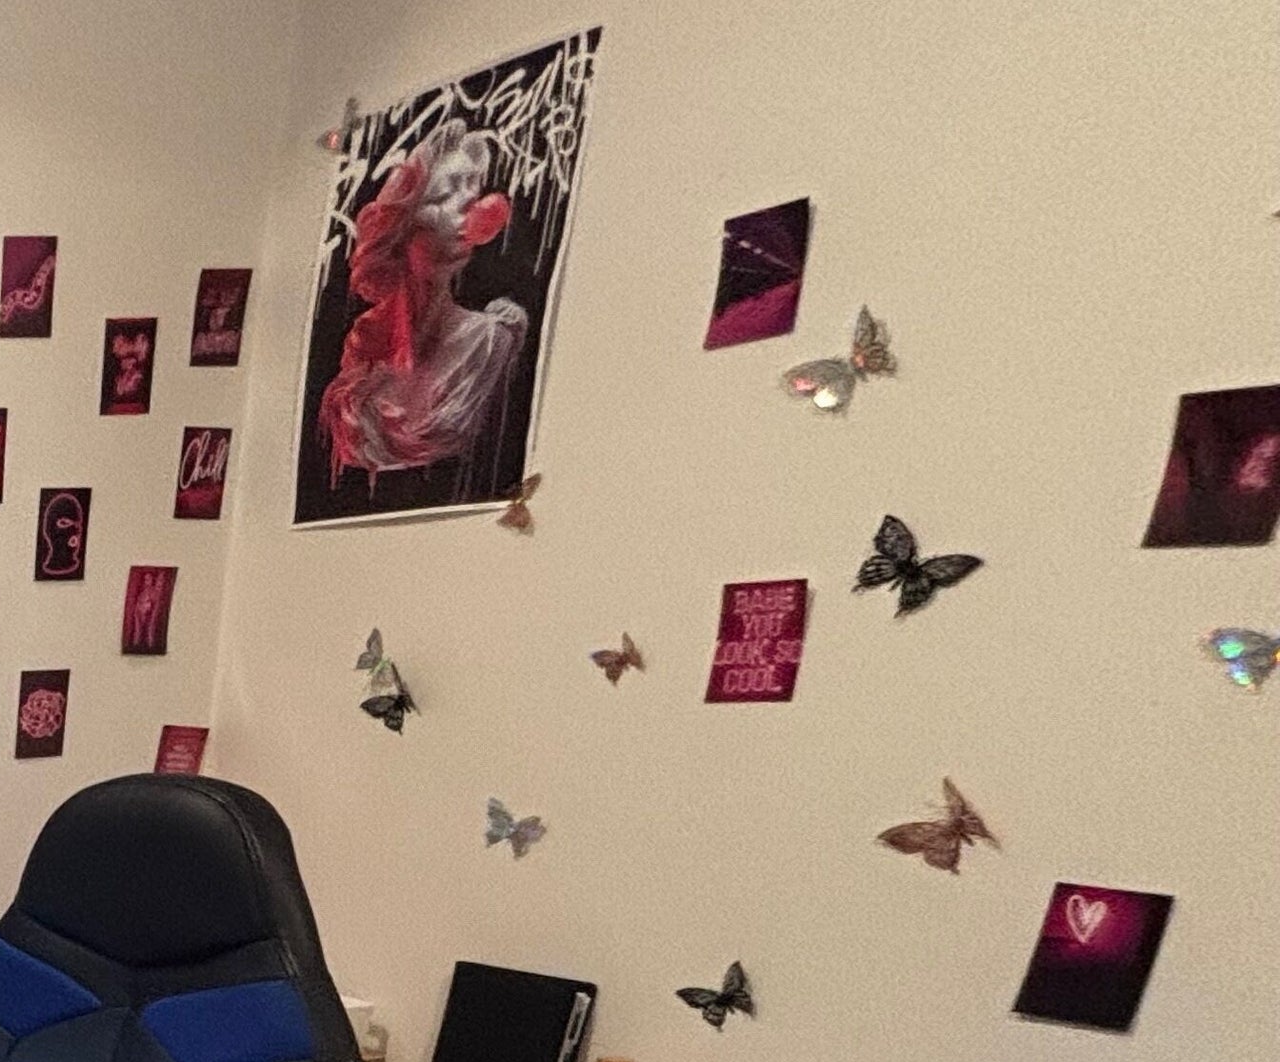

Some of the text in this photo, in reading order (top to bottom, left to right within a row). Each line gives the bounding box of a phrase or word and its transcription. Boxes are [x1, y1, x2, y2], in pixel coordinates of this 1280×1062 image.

[180, 430, 228, 490] Chill
[733, 587, 796, 614] BABE
[742, 612, 785, 639] YOU
[722, 664, 783, 694] COOL
